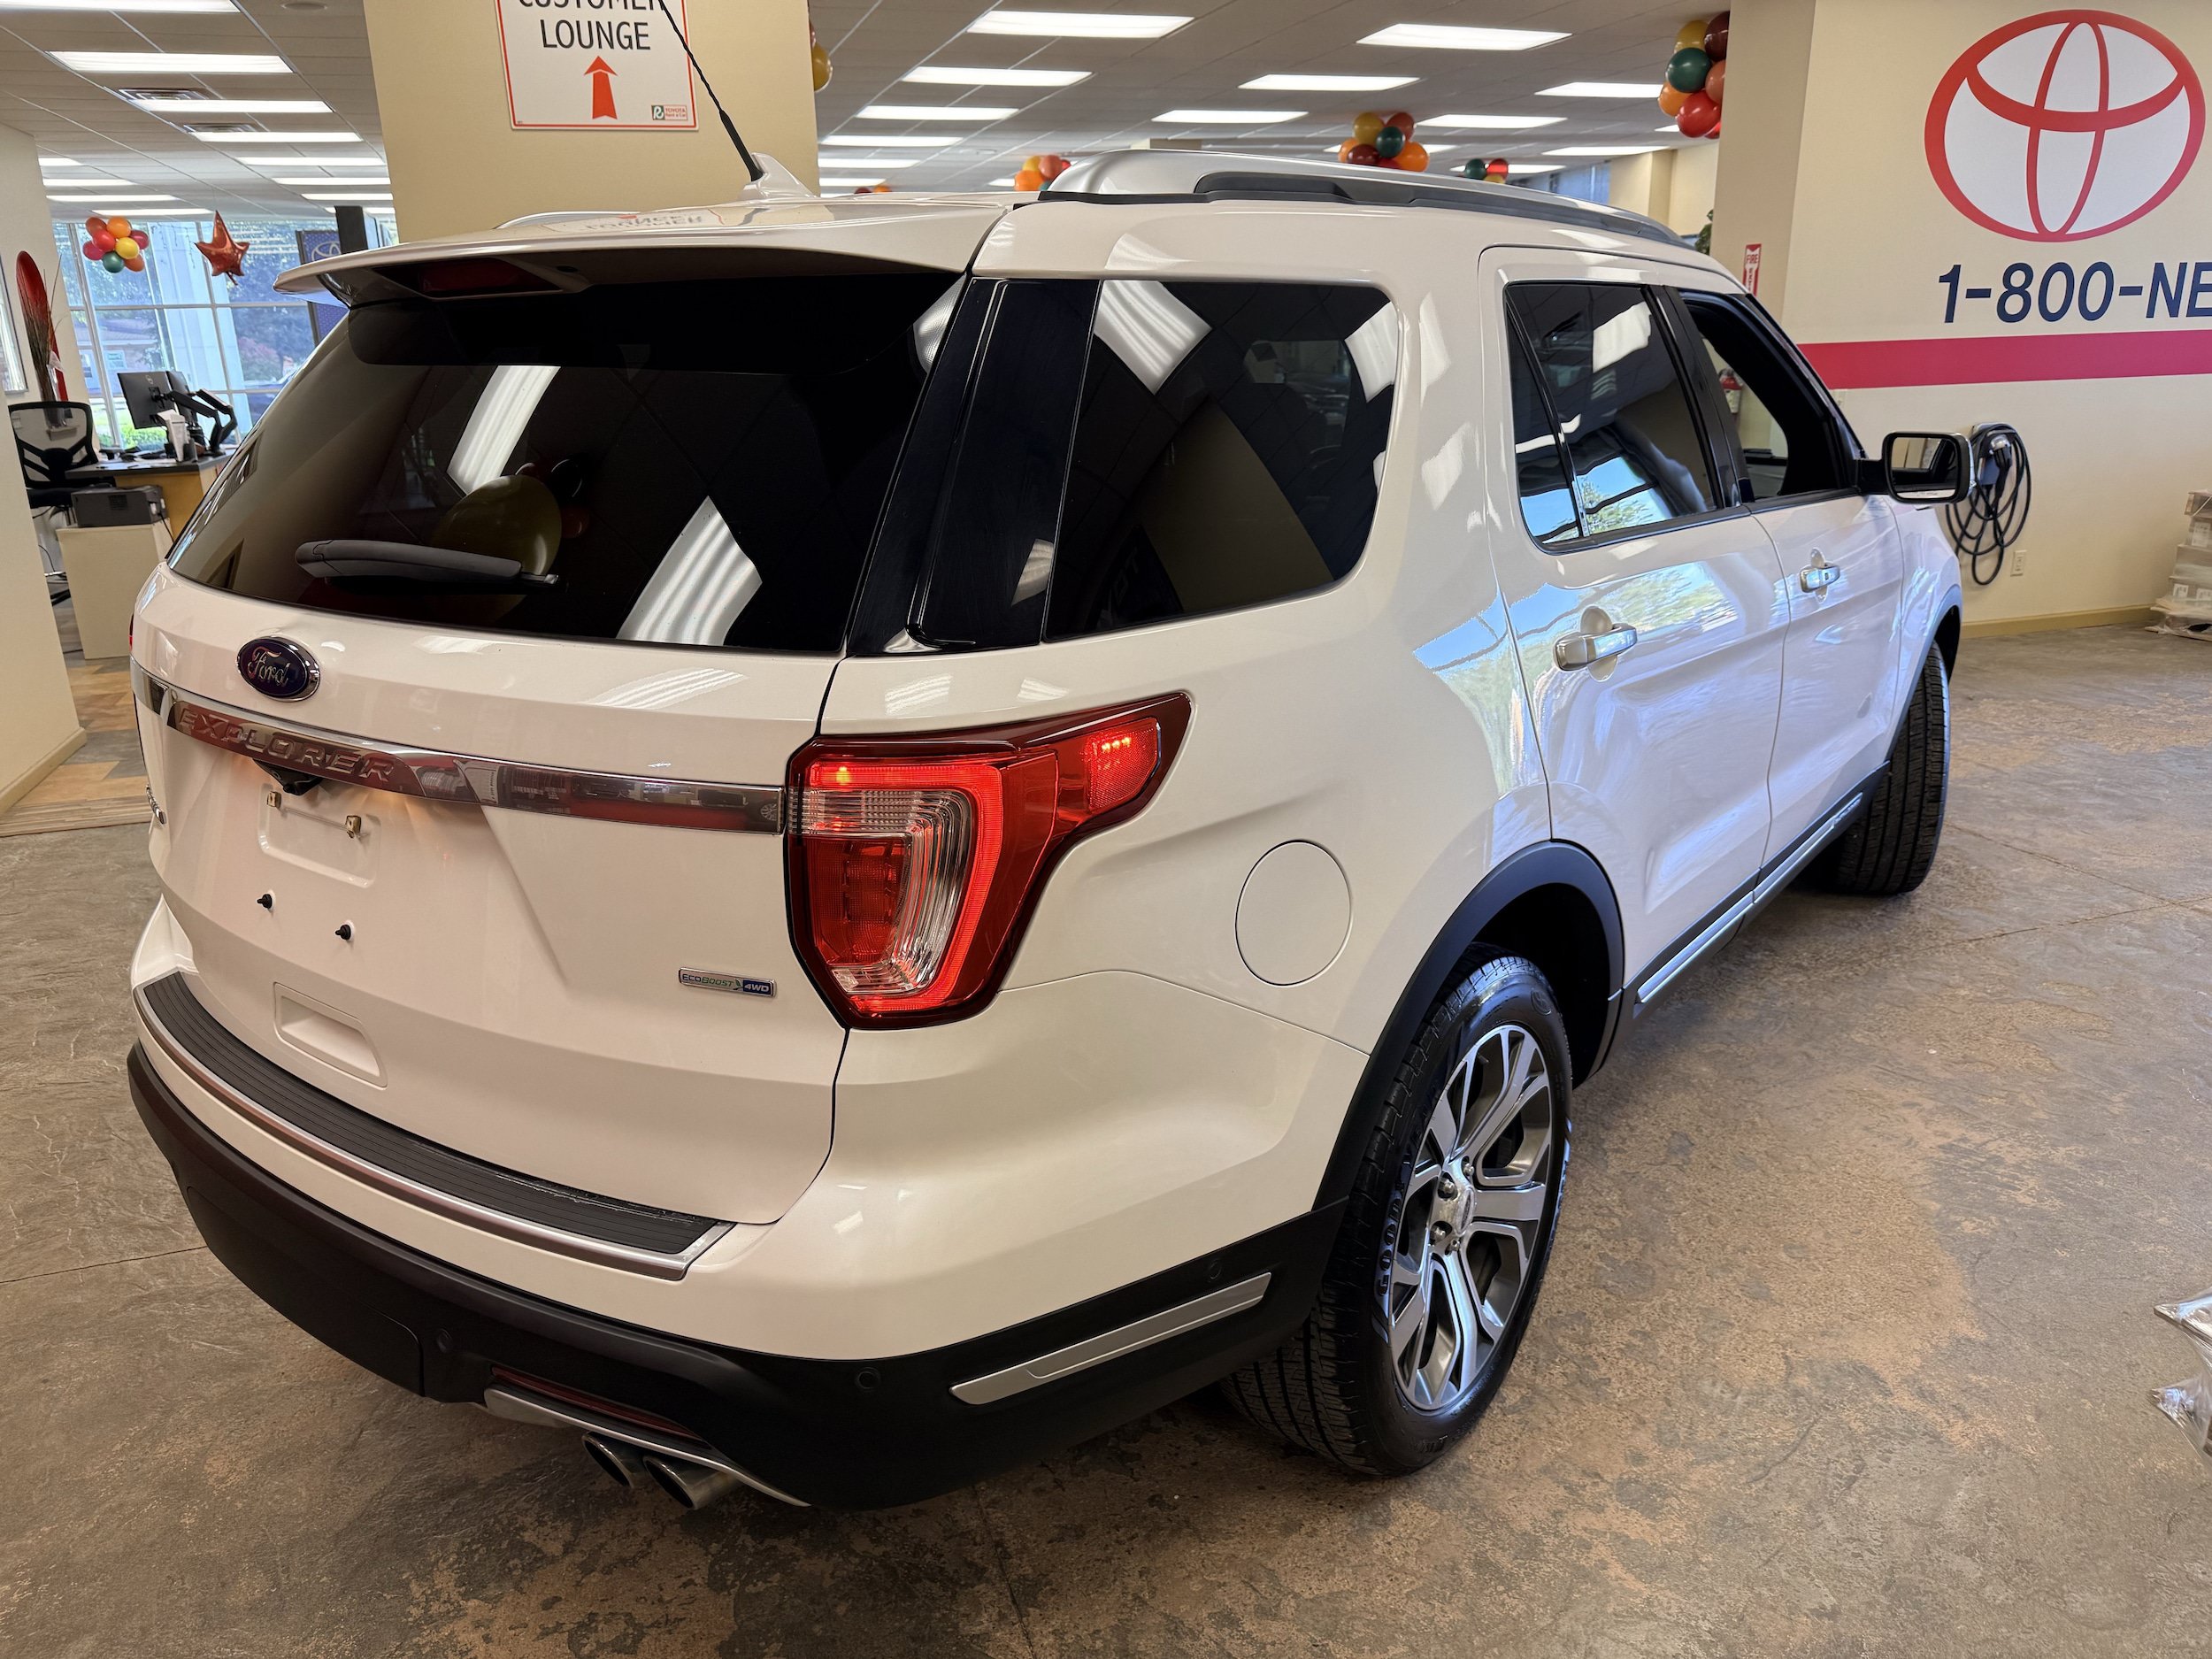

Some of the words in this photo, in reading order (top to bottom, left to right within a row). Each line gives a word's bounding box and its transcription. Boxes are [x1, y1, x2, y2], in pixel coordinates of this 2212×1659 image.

[540, 19, 651, 50] LOUNGE
[1747, 253, 1759, 264] FIRE
[248, 646, 291, 687] Ford
[179, 707, 396, 783] EXPLORER
[681, 973, 734, 987] ECOBOOST
[744, 982, 770, 992] 4WD
